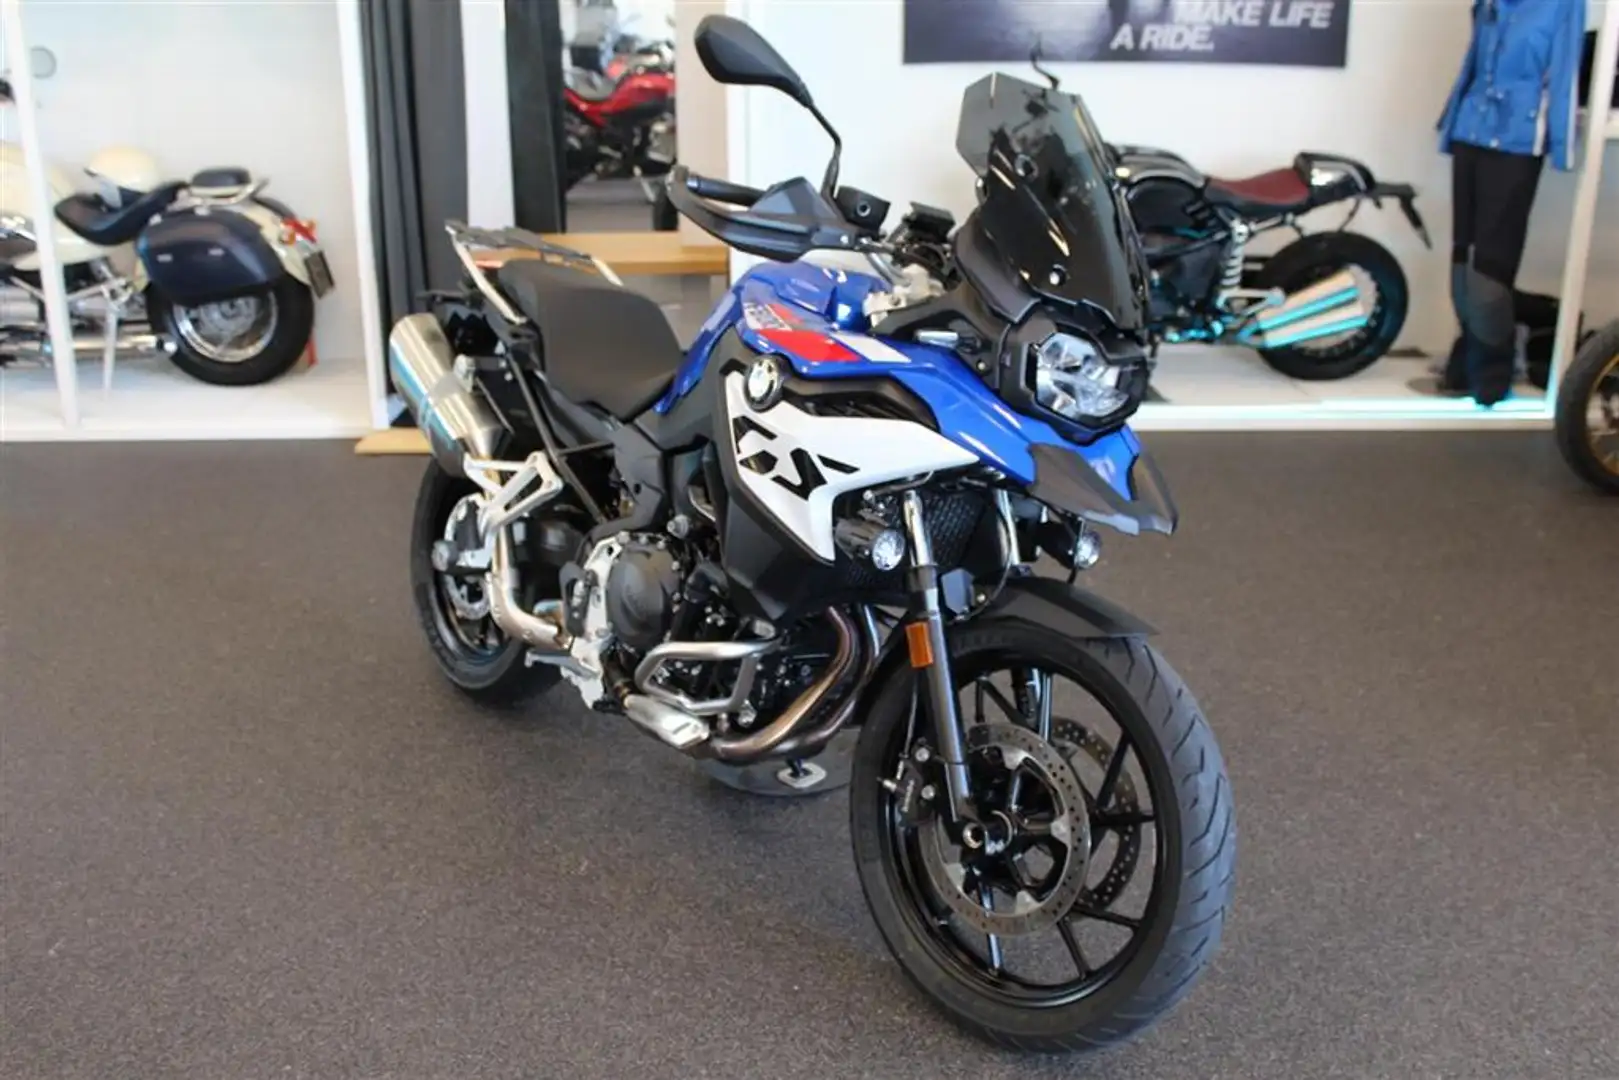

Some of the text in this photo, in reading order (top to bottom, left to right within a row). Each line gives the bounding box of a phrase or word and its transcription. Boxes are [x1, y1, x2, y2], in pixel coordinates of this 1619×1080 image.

[1174, 0, 1334, 28] MAKE LIFE
[1110, 24, 1214, 51] A RIDE.
